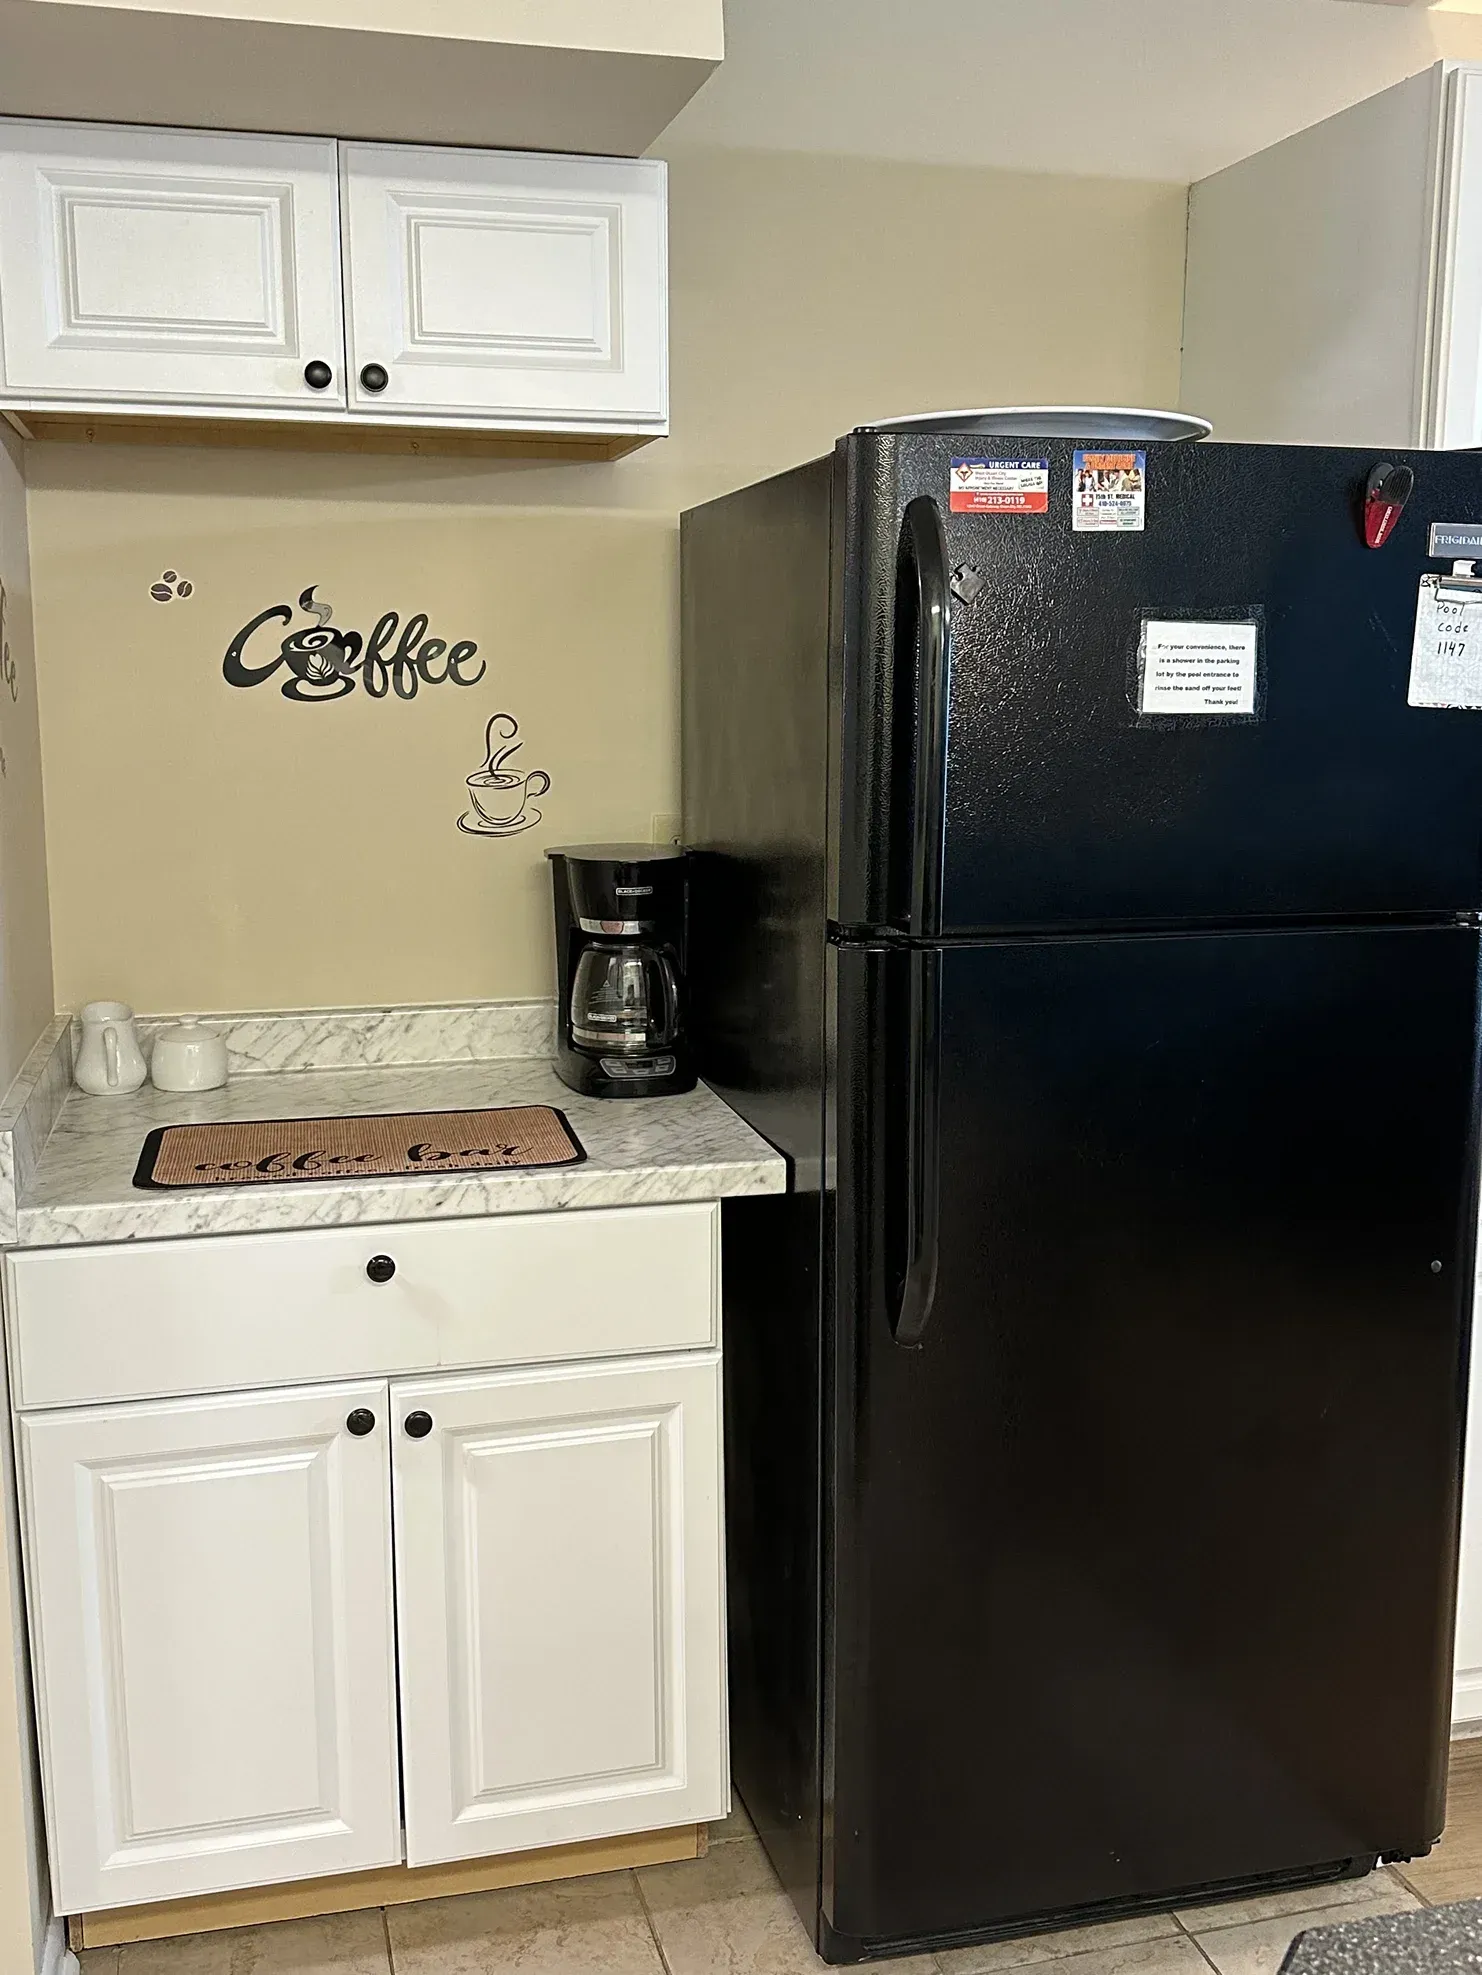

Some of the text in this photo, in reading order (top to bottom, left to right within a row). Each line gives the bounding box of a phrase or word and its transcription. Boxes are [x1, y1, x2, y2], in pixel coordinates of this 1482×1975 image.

[989, 461, 1041, 469] URGENT CARE
[987, 497, 1025, 505] 213-0119
[1435, 534, 1482, 546] FRIGIDAI
[1436, 601, 1465, 616] Pool
[222, 584, 487, 702] Coffee
[1437, 641, 1465, 656] 1147
[407, 1143, 534, 1162] bar
